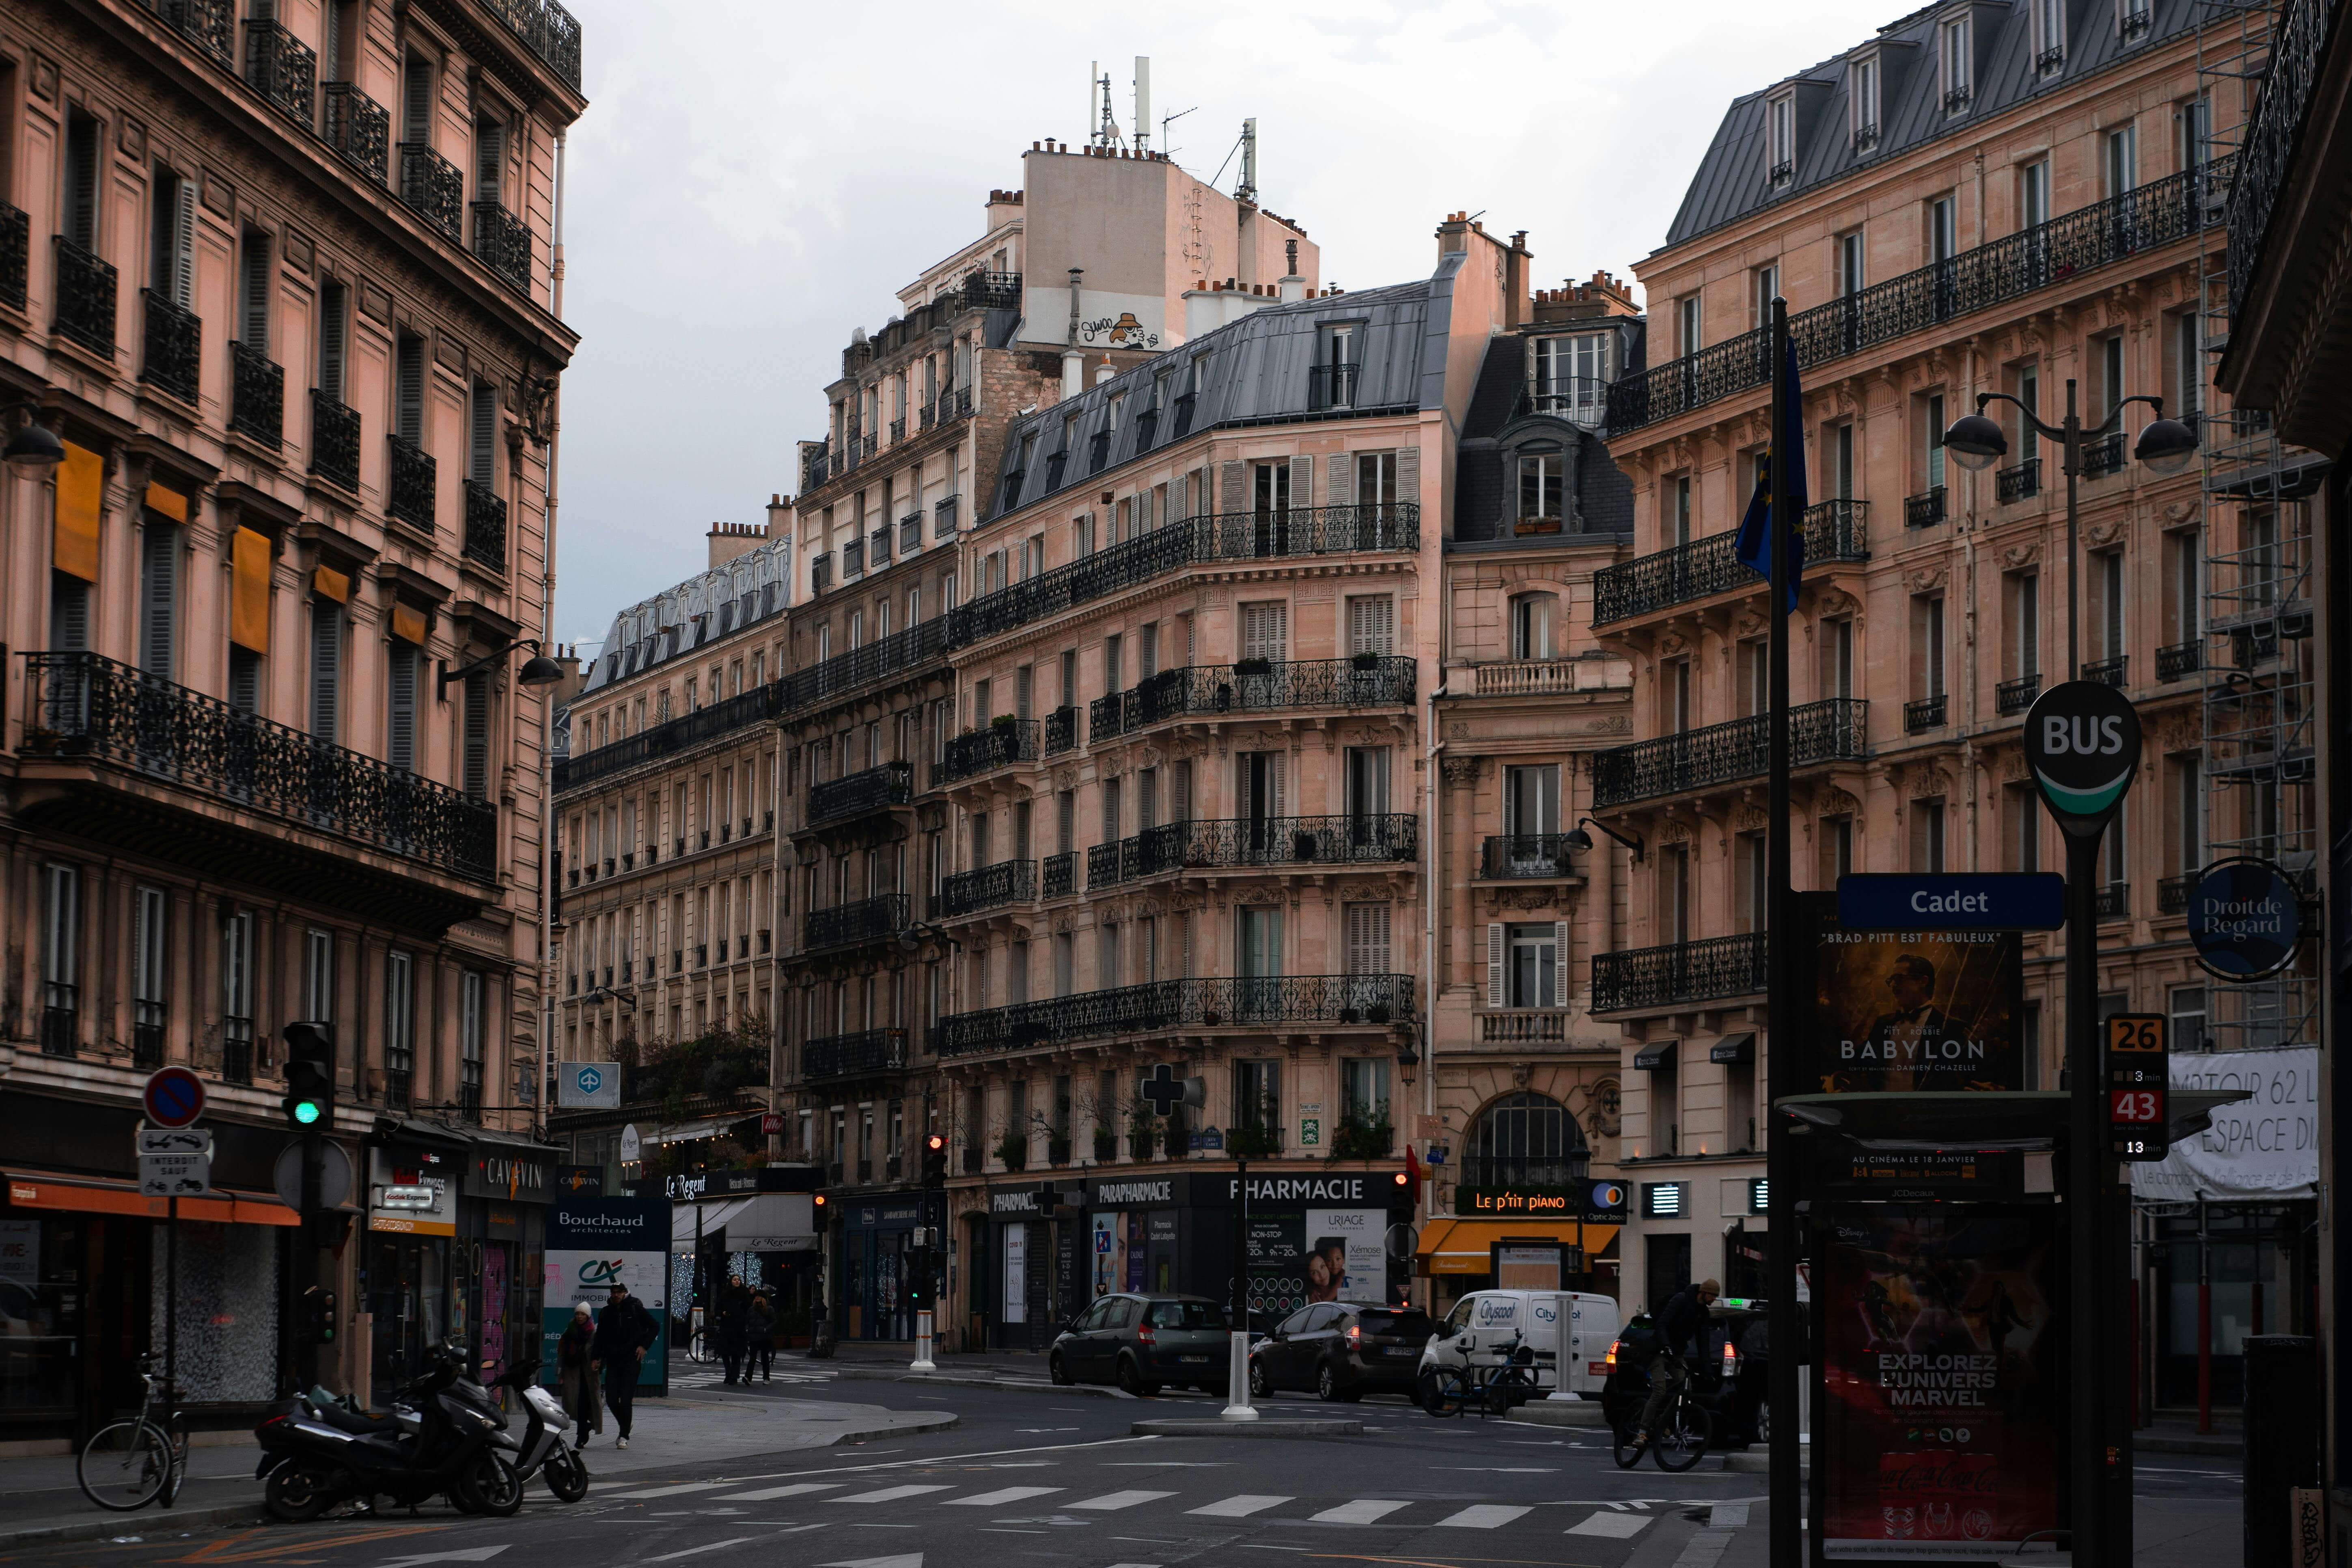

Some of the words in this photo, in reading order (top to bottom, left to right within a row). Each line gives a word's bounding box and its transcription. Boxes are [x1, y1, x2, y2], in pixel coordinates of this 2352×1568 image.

[2044, 716, 2123, 755] BUS
[1910, 890, 1989, 913] Cadet
[2204, 896, 2256, 915] Droit
[2257, 897, 2283, 915] de
[2204, 916, 2281, 942] Regard
[1822, 933, 1863, 943] "BRAD
[1869, 933, 1895, 943] PITT
[1900, 933, 1923, 943] EST
[1928, 932, 2001, 943] FABULEUX"
[2117, 1022, 2156, 1049] 26
[1841, 1040, 1984, 1059] BABYLON
[2270, 1070, 2296, 1104] 62
[565, 1097, 614, 1105] PIAGGIO
[2117, 1093, 2156, 1120] 43
[765, 1117, 782, 1130] illy
[2201, 1118, 2287, 1153] ESPACE
[2296, 1117, 2318, 1151] DI
[623, 1139, 627, 1148] Le
[626, 1139, 637, 1149] Regent
[2126, 1141, 2144, 1153] 13
[2145, 1145, 2162, 1153] min
[1869, 1154, 1905, 1163] CINÉMA
[487, 1158, 542, 1189] CAVAVIN
[560, 1177, 599, 1185] CAVAVIN
[665, 1175, 675, 1198] Le
[676, 1174, 706, 1201] Regent
[1099, 1181, 1171, 1204] PARAPHARMACIE
[1230, 1179, 1364, 1200] PHARMACIE
[1891, 1189, 1936, 1197] JCDecaux
[559, 1212, 644, 1227] Bouchaud
[1328, 1215, 1364, 1226] URIAGE
[1587, 1213, 1608, 1222] Optic
[1608, 1213, 1626, 1221] 2000
[1154, 1221, 1172, 1229] Pharmacie
[750, 1238, 761, 1246] Le
[764, 1238, 798, 1247] Regent
[1151, 1232, 1160, 1241] Cadet
[1160, 1232, 1176, 1242] Lafayette
[1249, 1248, 1263, 1256] 20h
[1269, 1249, 1278, 1257] 9h
[1350, 1244, 1381, 1254] Xémose
[1610, 1266, 1620, 1277] T
[1481, 1300, 1516, 1326] Cityscoot
[1878, 1354, 1997, 1370] EXPLOREZ
[1880, 1372, 1997, 1389] L'UNIVERS
[1891, 1389, 1986, 1406] MARVEL
[1826, 1545, 1838, 1553] Pour
[1853, 1545, 1869, 1553] santé,
[1895, 1547, 1914, 1555] manger
[1916, 1546, 1927, 1555] trop
[1927, 1547, 1940, 1555] gras,
[1942, 1547, 1952, 1555] trop
[1953, 1546, 1968, 1555] sucré,
[1970, 1547, 1980, 1555] trop
